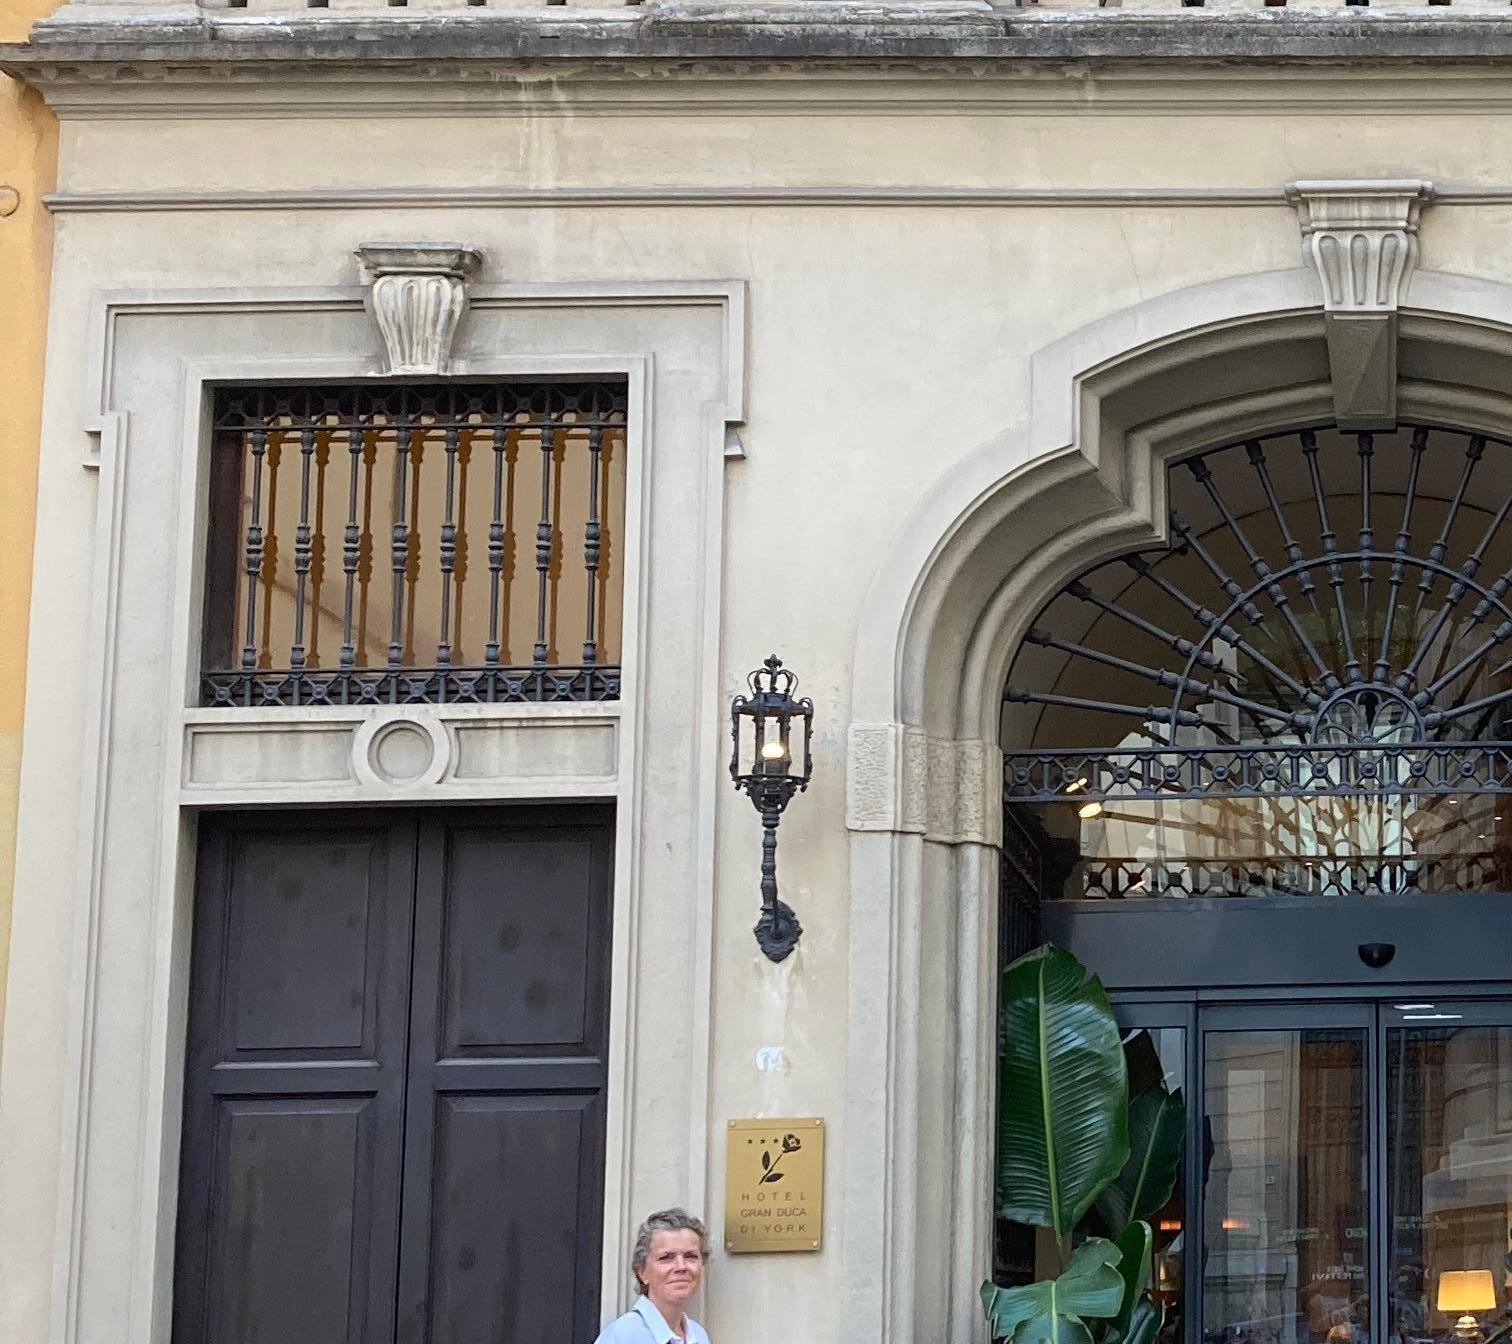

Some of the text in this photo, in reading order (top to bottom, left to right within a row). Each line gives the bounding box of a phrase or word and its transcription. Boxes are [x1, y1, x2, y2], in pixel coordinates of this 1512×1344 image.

[741, 1192, 806, 1202] HOTEL
[740, 1207, 808, 1219] GRAN DUCA
[740, 1223, 807, 1234] DI YORK
